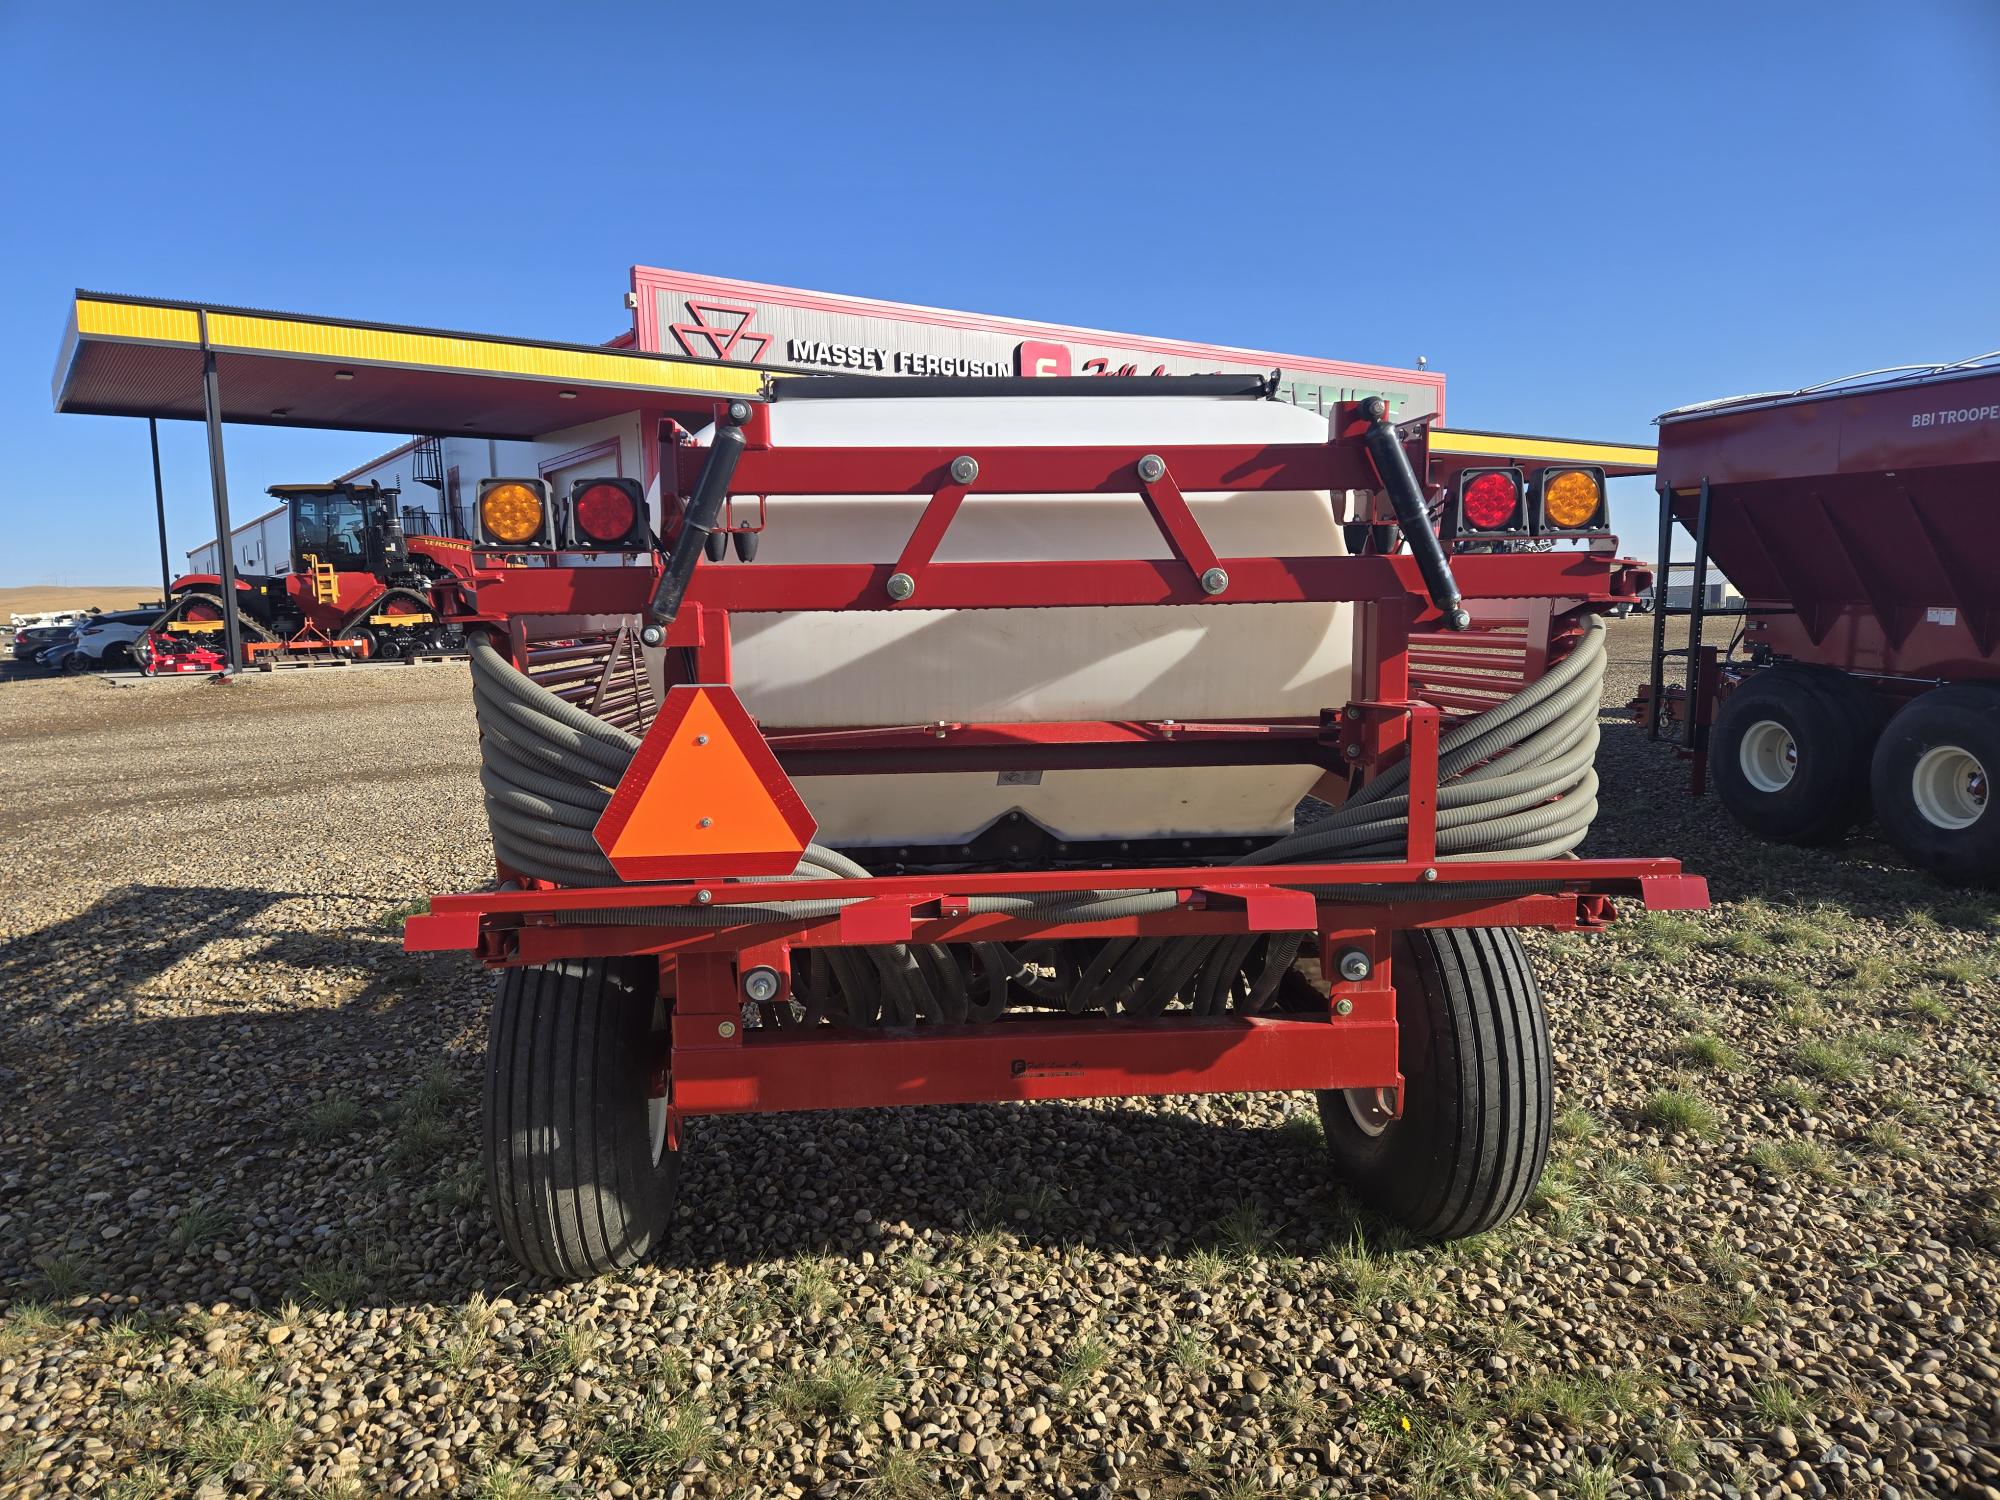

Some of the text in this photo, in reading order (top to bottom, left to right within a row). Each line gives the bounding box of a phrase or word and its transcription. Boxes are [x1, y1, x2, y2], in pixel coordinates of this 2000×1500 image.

[789, 338, 1013, 377] MASSEY FERGUSON
[1911, 405, 2000, 428] BBI TROOPE
[424, 539, 473, 553] VERSATILE
